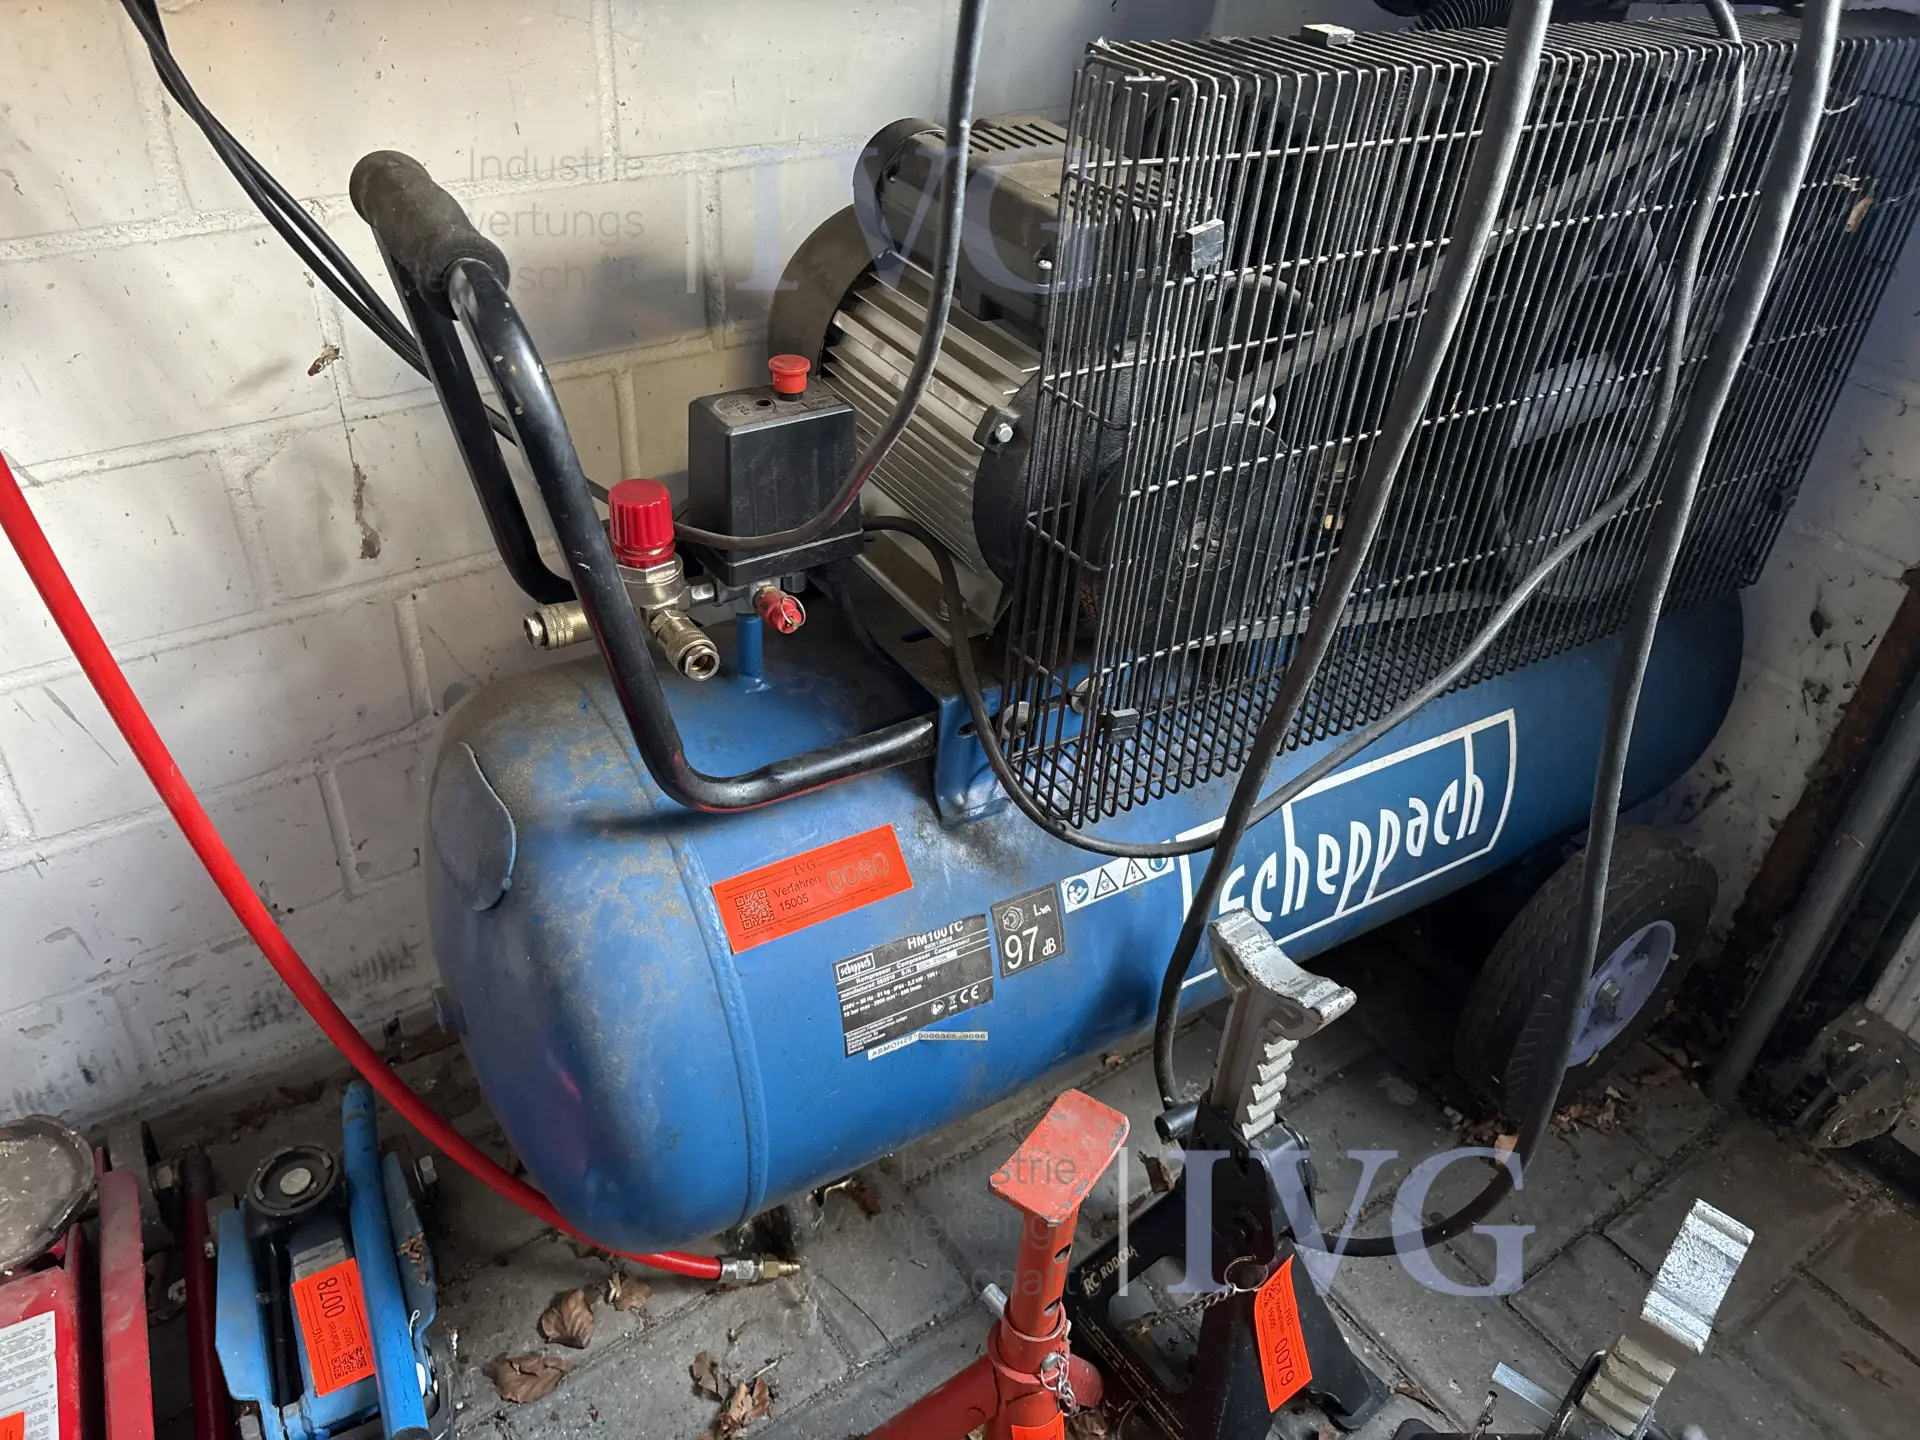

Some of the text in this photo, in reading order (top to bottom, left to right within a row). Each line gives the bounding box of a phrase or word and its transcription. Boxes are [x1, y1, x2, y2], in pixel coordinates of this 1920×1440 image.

[1217, 733, 1485, 922] scheppach
[793, 859, 817, 876] IVG
[827, 852, 889, 893] 0080
[774, 875, 821, 898] Verfahren
[779, 893, 809, 912] 15005
[1005, 925, 1056, 969] 97 dB
[856, 967, 891, 984] Kompressor
[896, 952, 931, 969] Compressor
[317, 1277, 346, 1319] 0078
[1284, 1308, 1294, 1326] IVG
[312, 1327, 325, 1345] IVG
[1274, 1337, 1295, 1386] 0079
